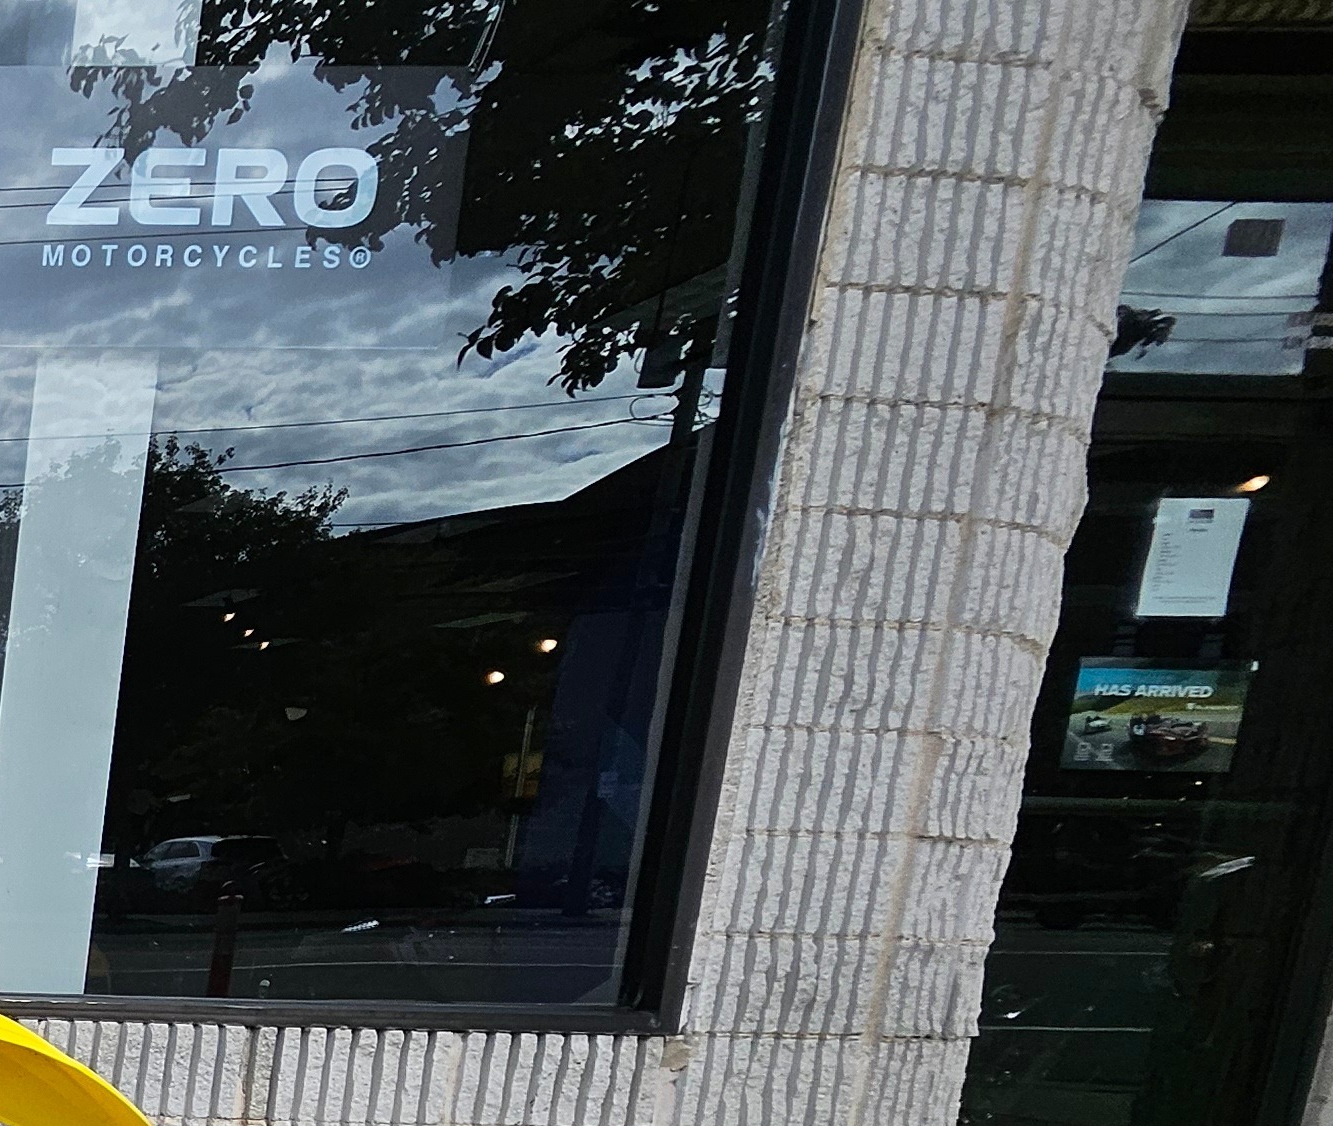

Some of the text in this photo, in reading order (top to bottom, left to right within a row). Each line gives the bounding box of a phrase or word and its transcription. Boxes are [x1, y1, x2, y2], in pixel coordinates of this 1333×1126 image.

[46, 147, 379, 228] ZERO
[1093, 684, 1214, 698] HAS ARRIVED
